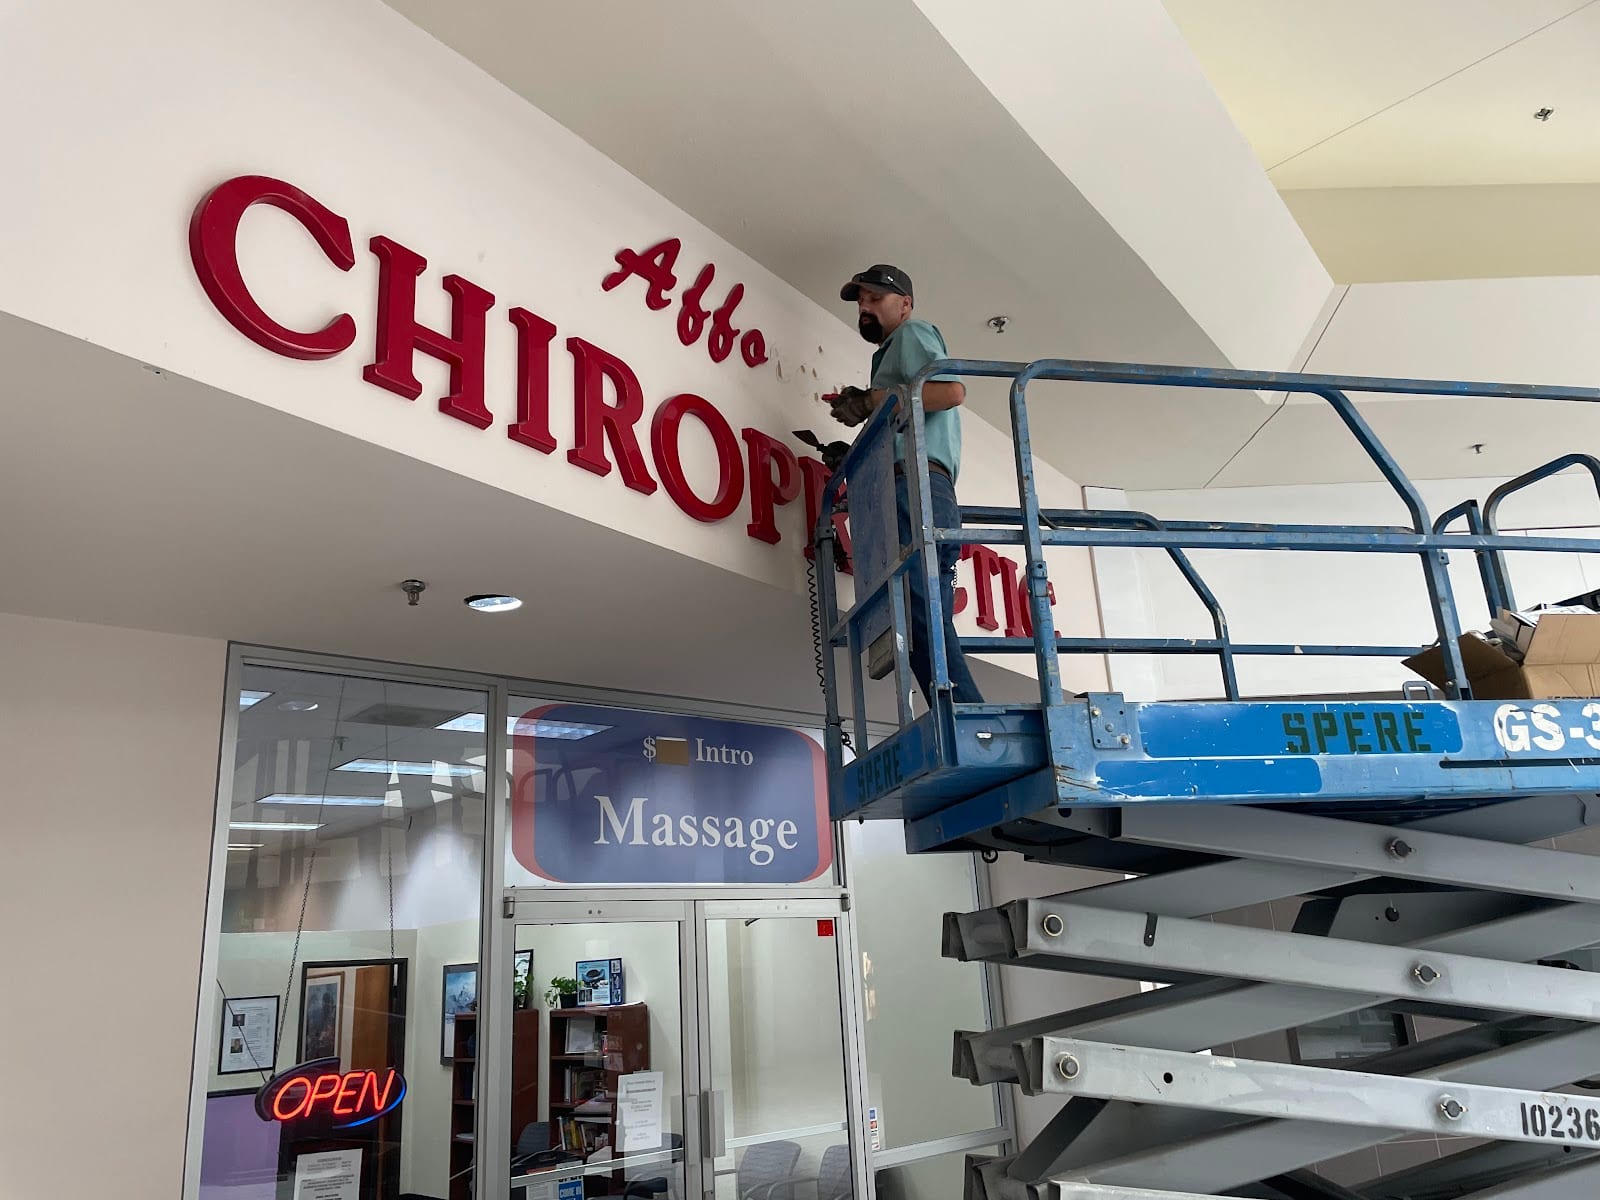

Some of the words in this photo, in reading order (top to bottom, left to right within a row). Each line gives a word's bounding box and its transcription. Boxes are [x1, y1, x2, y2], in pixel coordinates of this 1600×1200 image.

[695, 737, 754, 766] Intro
[1281, 711, 1432, 753] SPERE
[593, 795, 798, 866] Massage
[272, 1068, 396, 1120] OPEN
